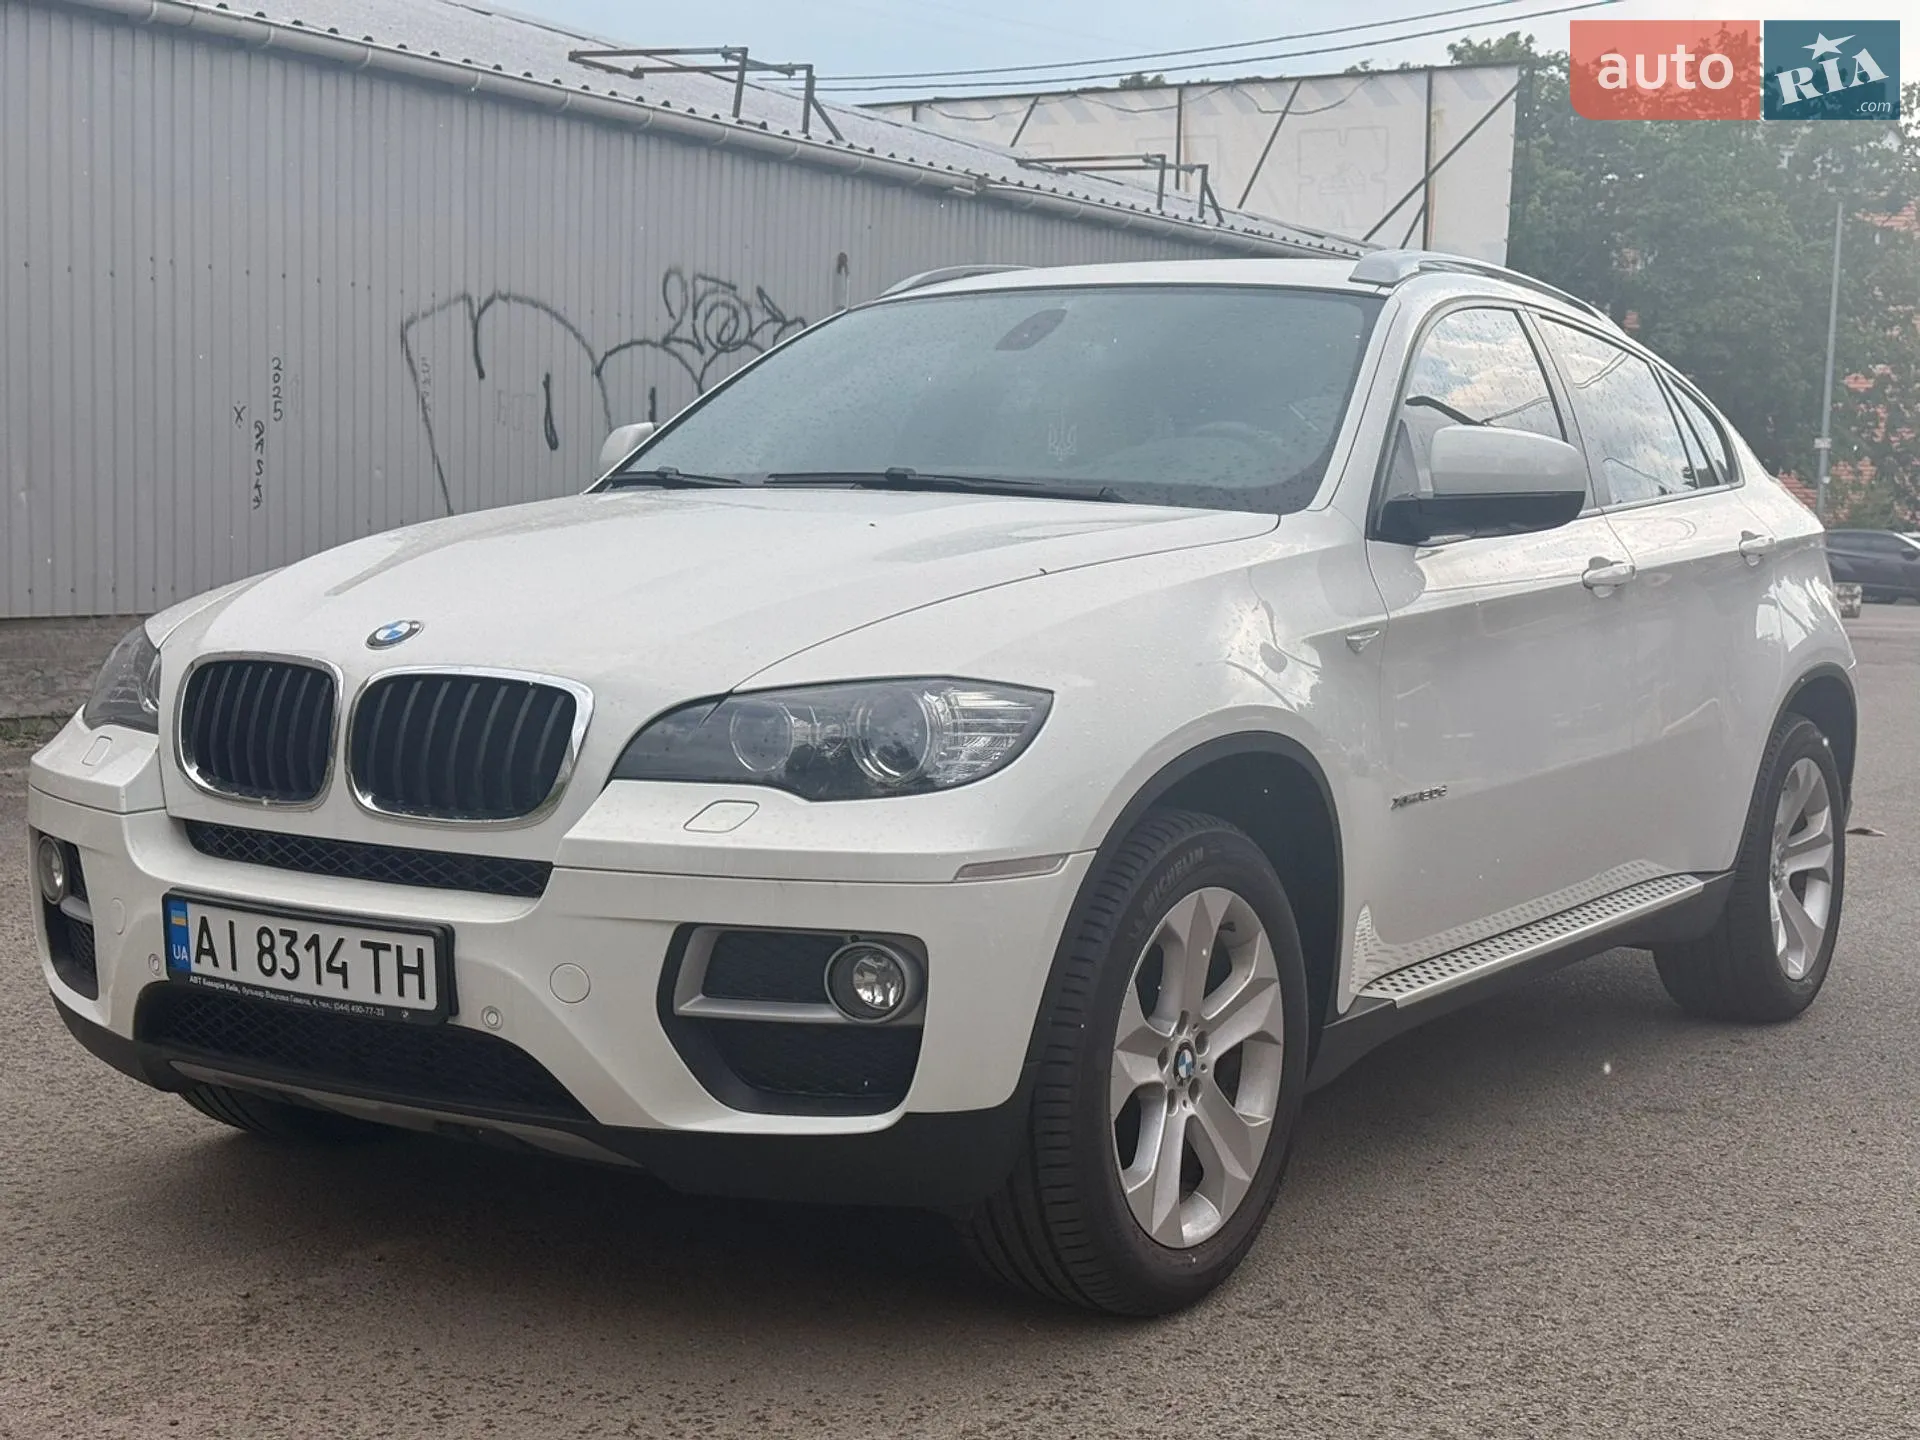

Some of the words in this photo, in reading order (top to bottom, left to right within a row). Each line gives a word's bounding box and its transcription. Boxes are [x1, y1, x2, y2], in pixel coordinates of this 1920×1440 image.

[1142, 846, 1204, 920] MICHELIN
[171, 943, 189, 961] UA
[194, 915, 238, 972] AI
[256, 925, 349, 990] 8314
[360, 939, 426, 1001] TH
